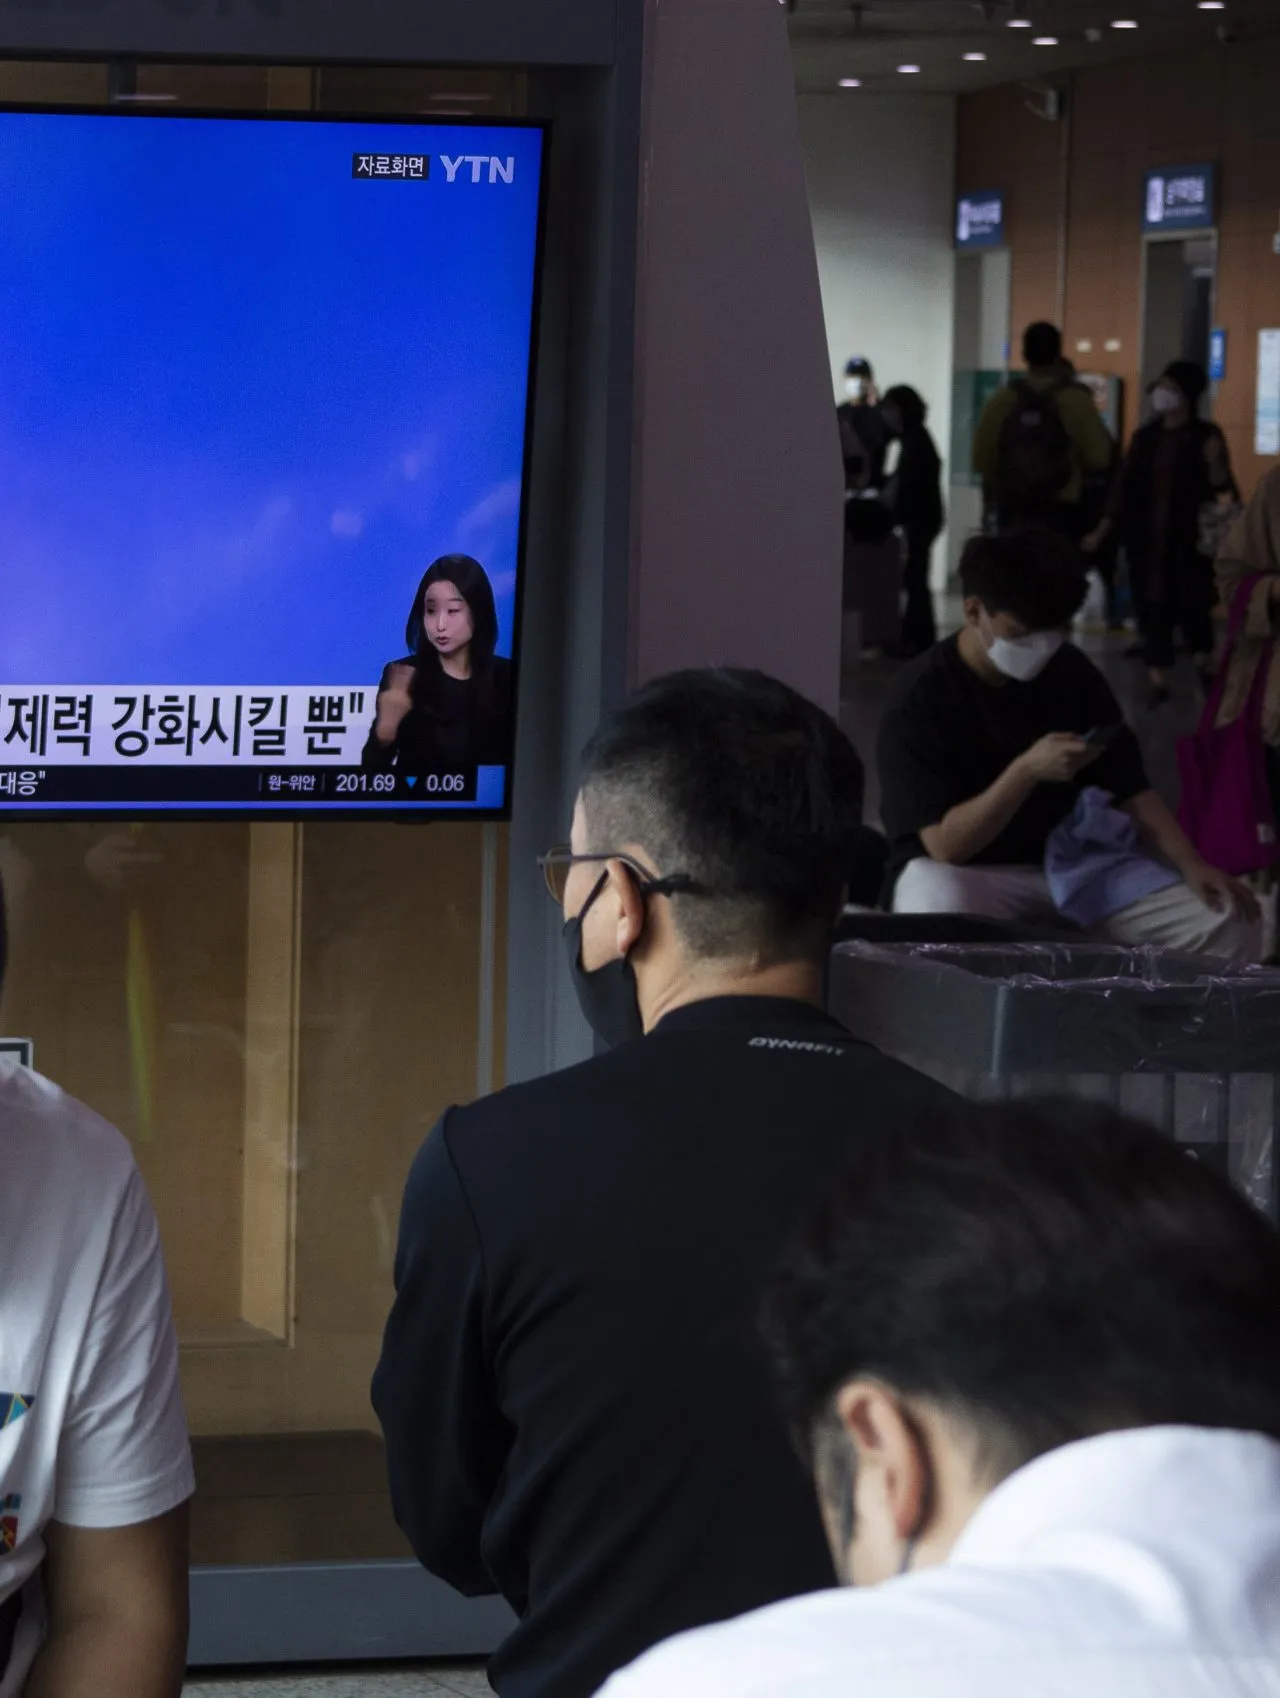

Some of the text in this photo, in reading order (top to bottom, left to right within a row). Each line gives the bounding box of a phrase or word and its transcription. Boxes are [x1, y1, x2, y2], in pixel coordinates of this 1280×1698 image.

[357, 155, 424, 178] 자료화면
[439, 155, 515, 184] YTN
[111, 693, 289, 757] 강화시킬
[303, 691, 365, 756] 뿐"
[268, 774, 317, 792] 원-위안
[335, 773, 465, 793] 201.69 0.06
